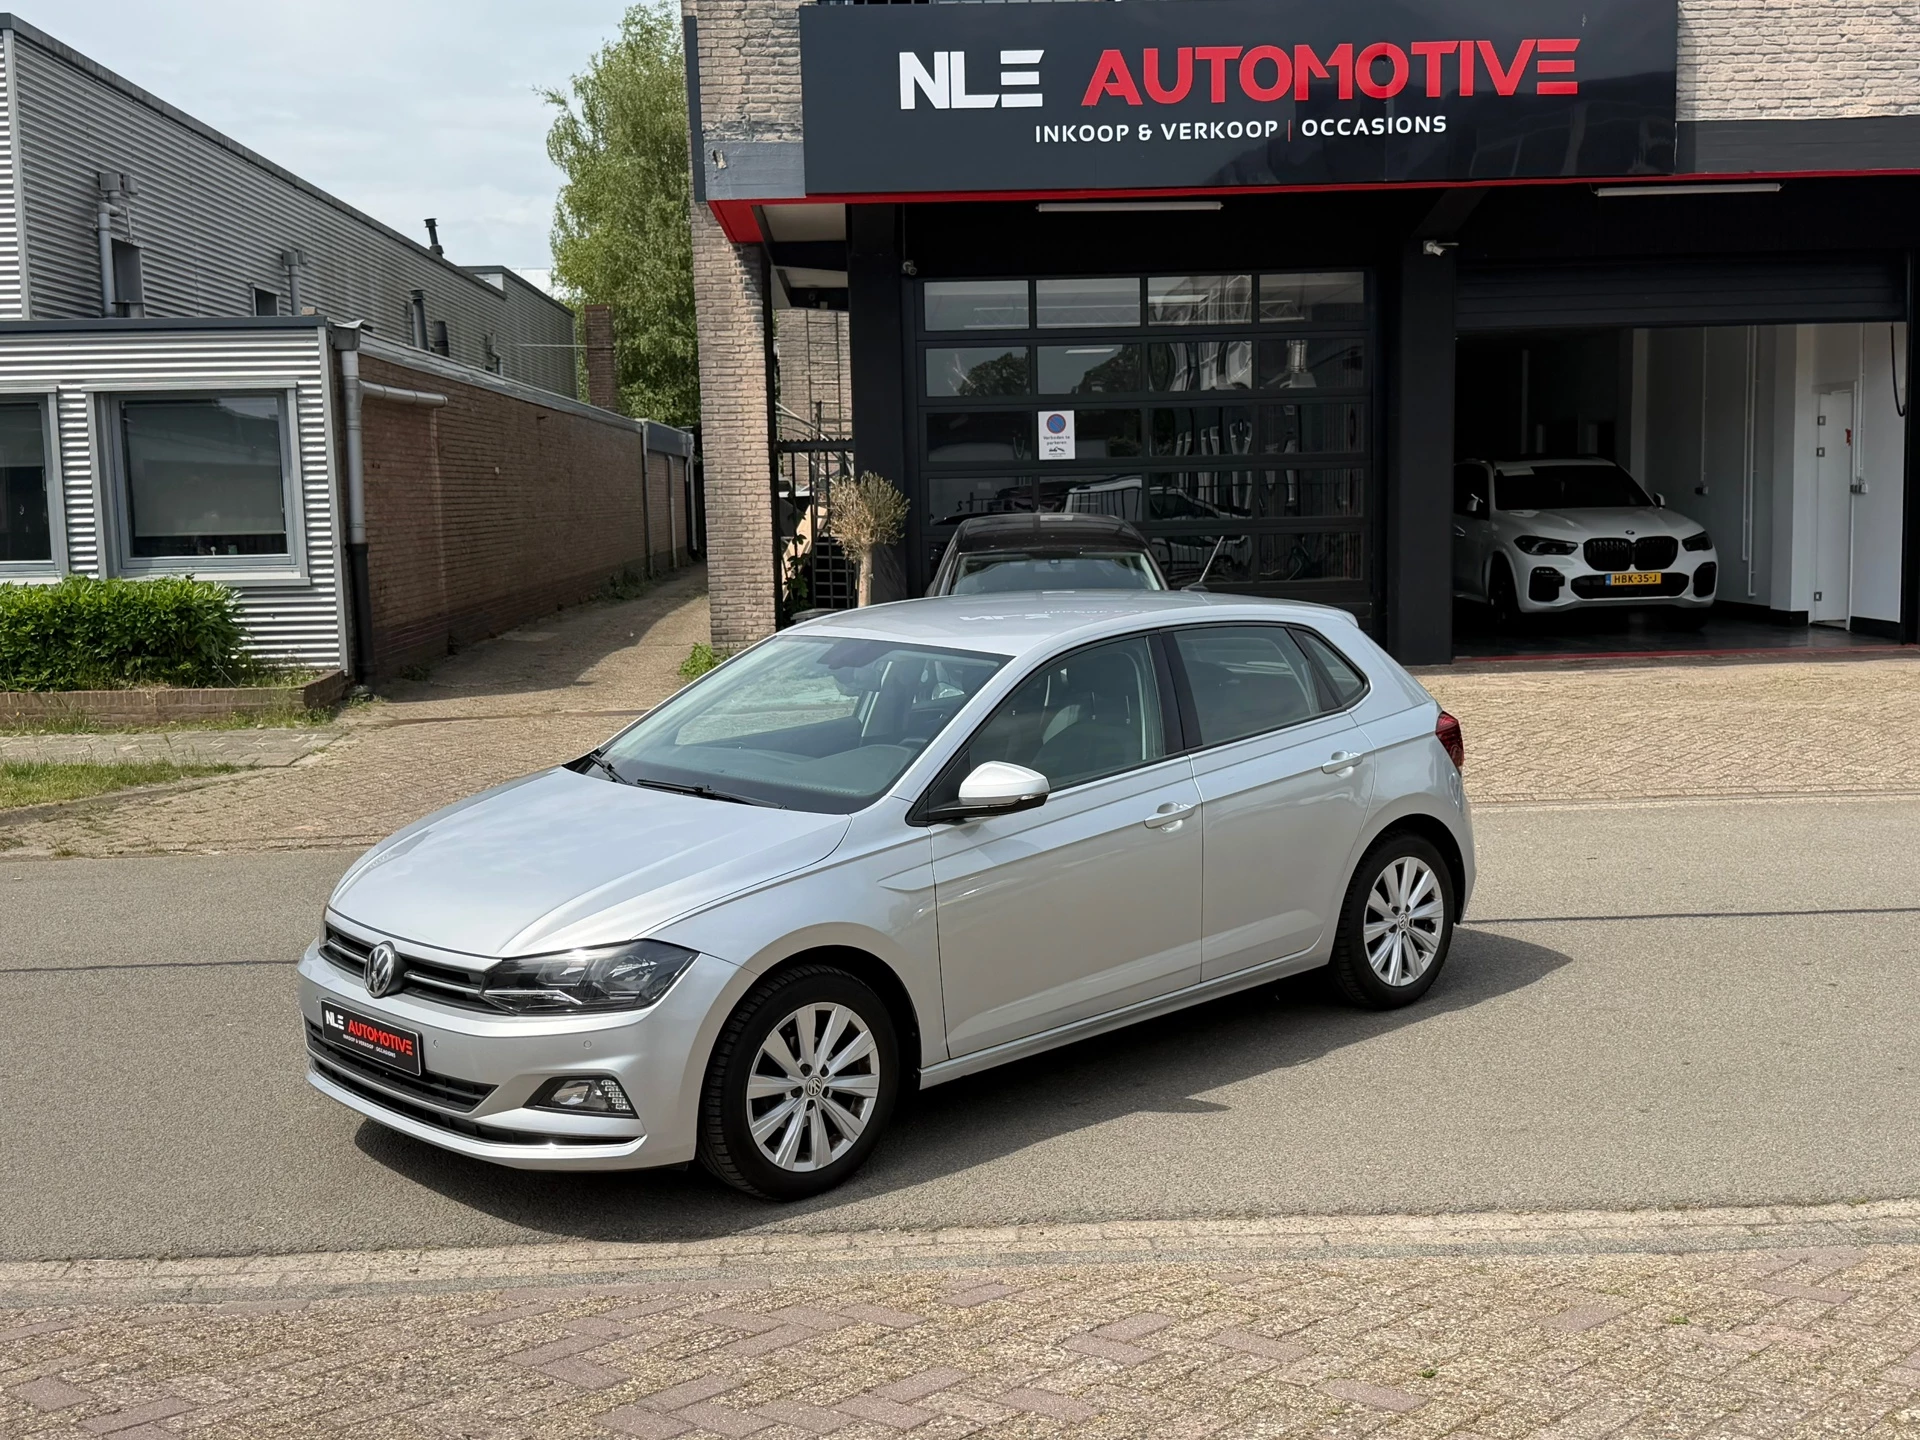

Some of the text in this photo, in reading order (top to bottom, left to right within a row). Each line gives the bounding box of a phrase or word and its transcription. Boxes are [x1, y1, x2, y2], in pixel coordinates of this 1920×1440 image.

[899, 38, 1581, 109] NLE AUTOMOTIVE
[1035, 115, 1447, 143] INKOOP & VERKOOP OCCASIONS
[1614, 574, 1657, 584] HBK-35-J
[325, 1009, 413, 1056] NLE AUTOMOTIVE
